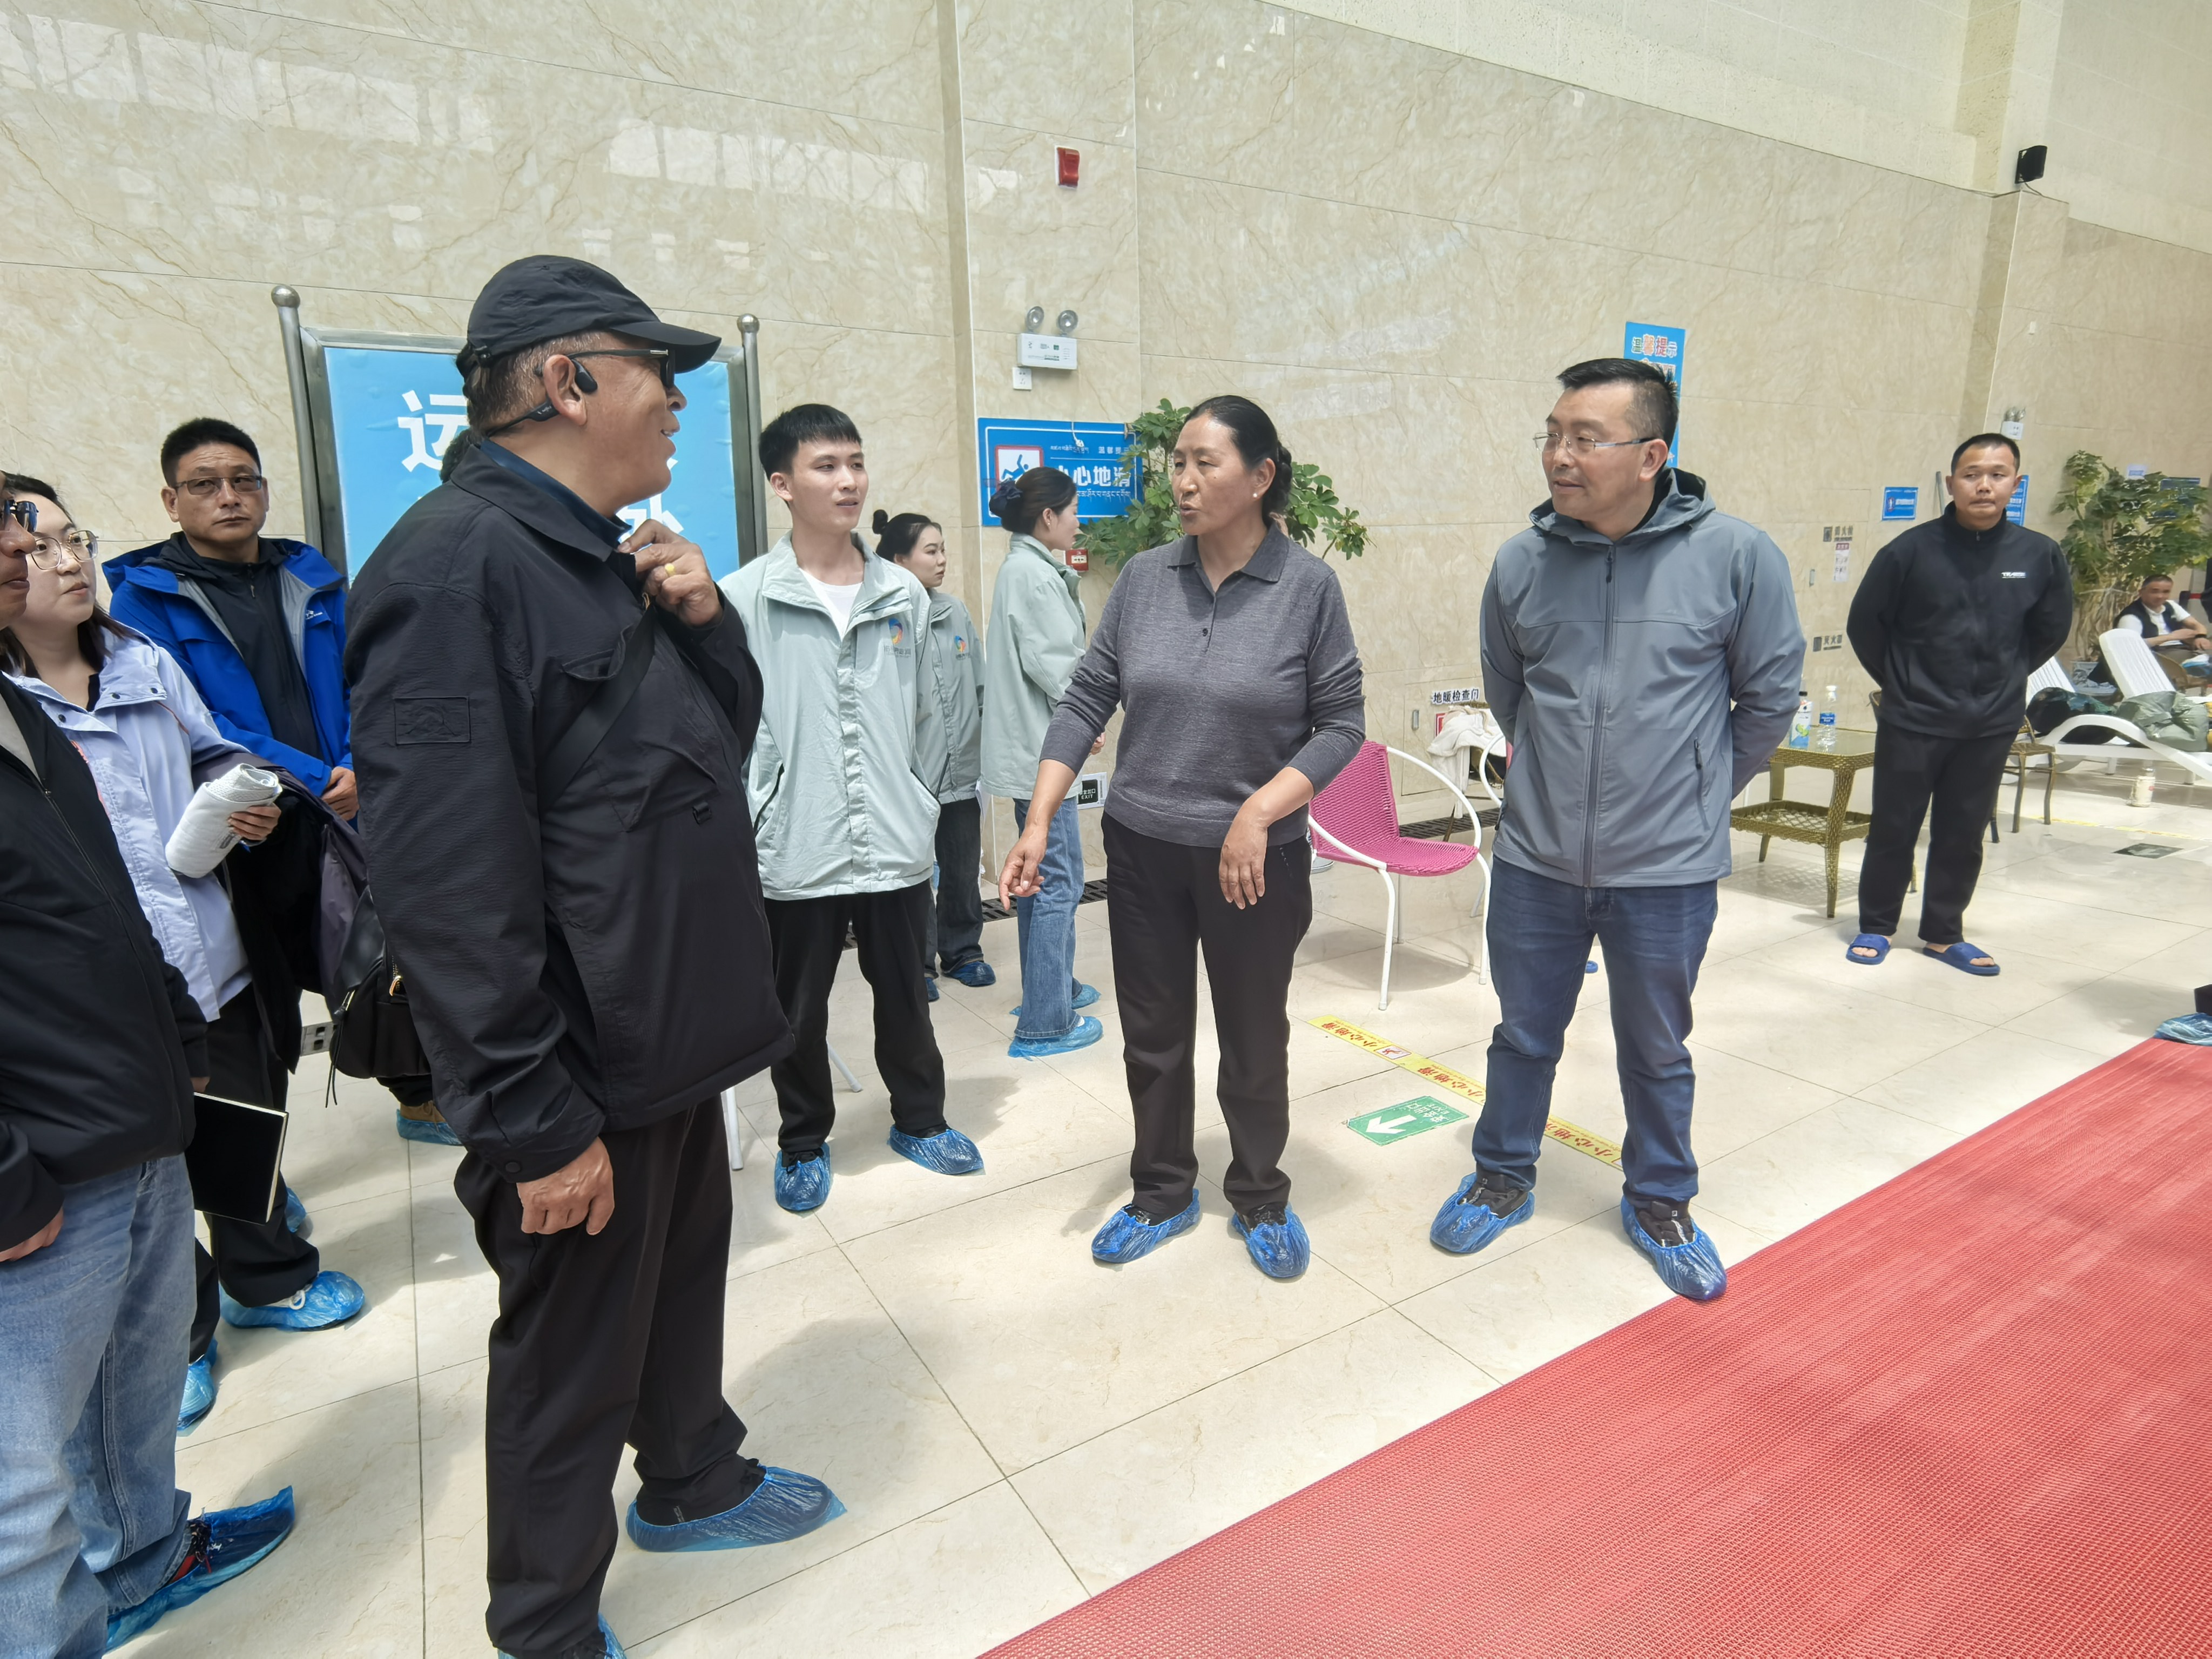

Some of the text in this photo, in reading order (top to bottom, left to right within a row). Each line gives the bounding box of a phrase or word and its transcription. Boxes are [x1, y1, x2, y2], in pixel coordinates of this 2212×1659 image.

[1631, 334, 1677, 358] 温馨提示
[1433, 688, 1479, 703] 地暖检查门
